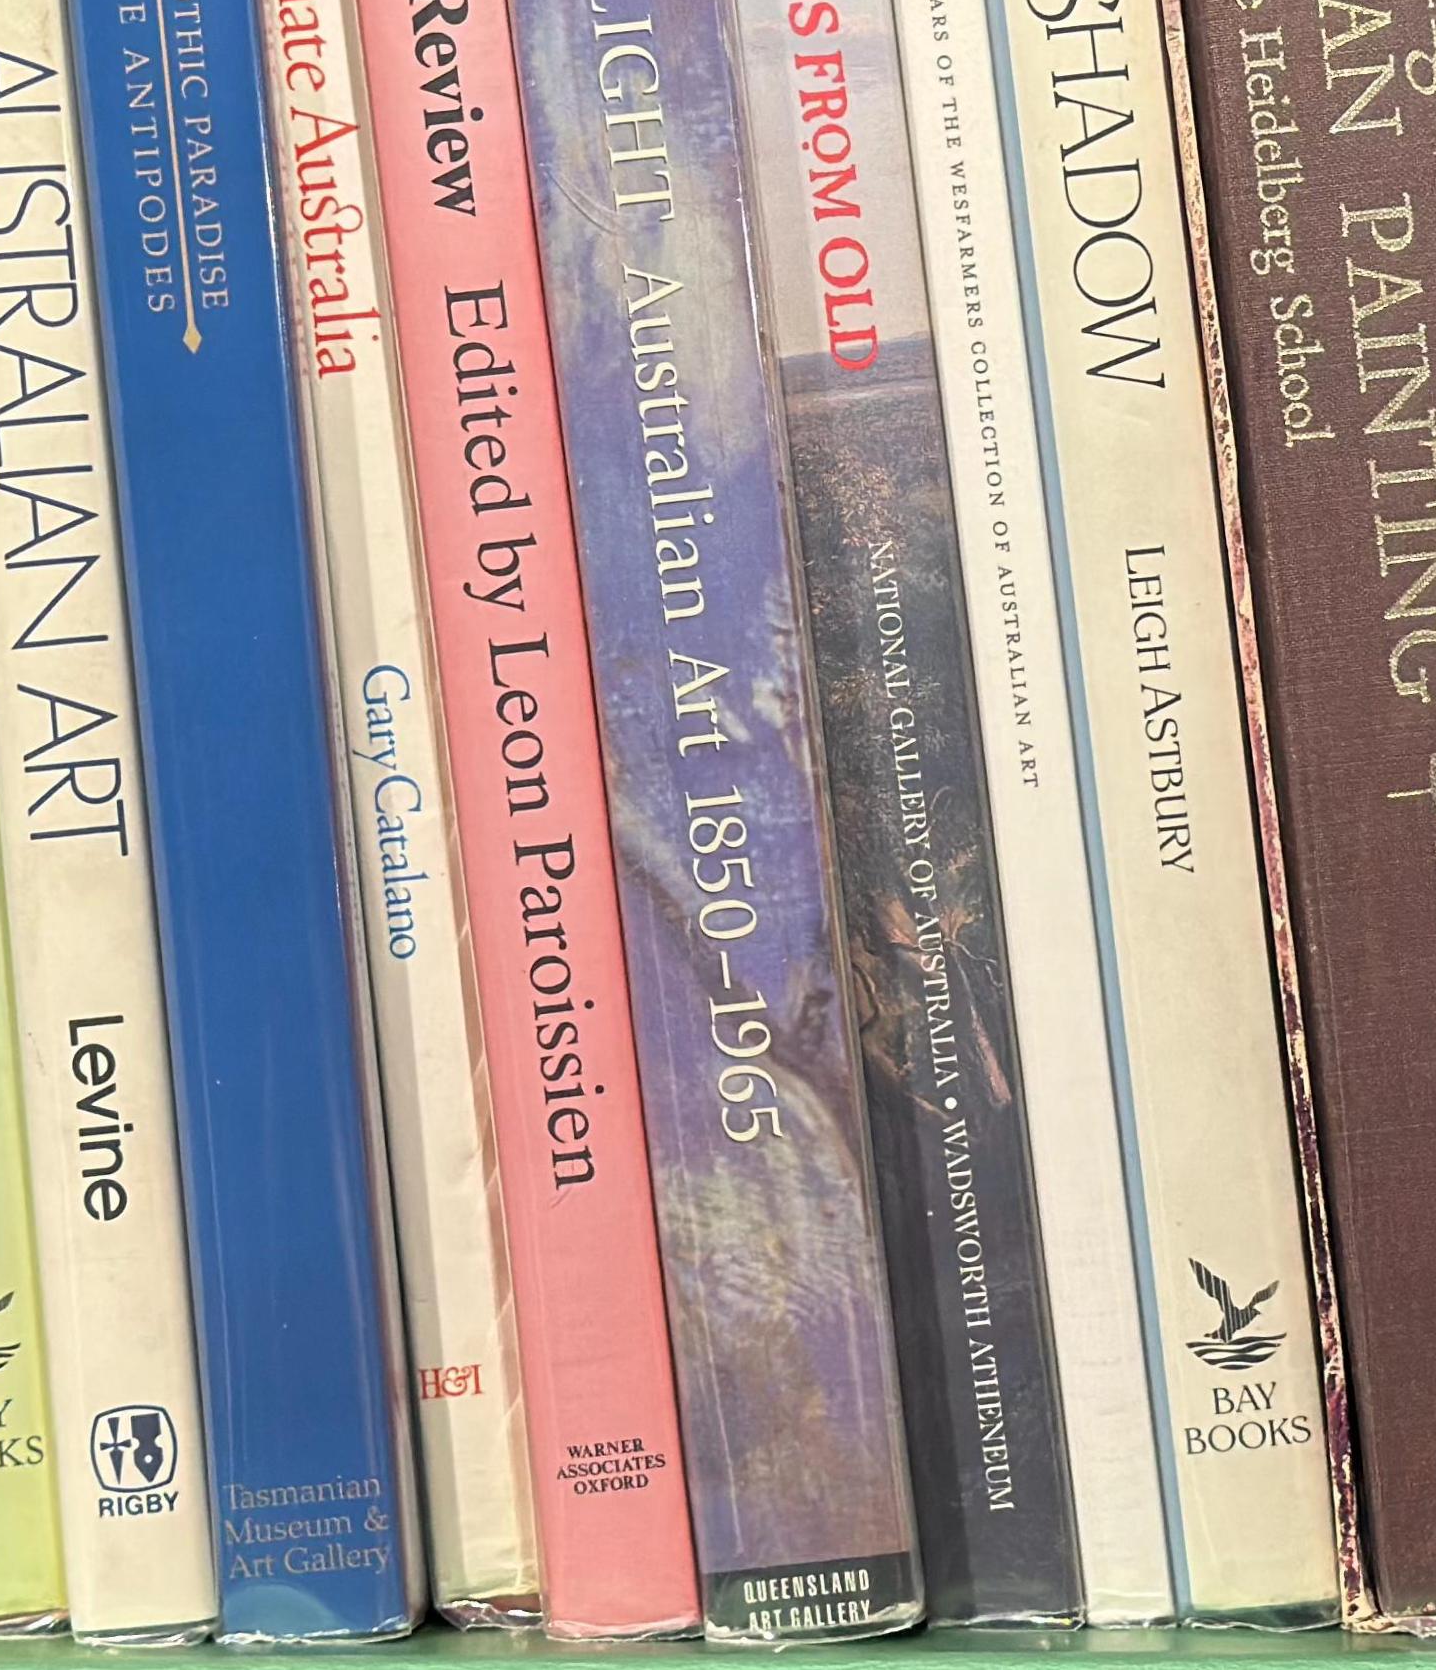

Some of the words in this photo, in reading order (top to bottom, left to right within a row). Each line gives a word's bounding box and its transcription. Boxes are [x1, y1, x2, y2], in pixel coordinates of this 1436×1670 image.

[797, 50, 861, 223] FROM
[937, 54, 953, 89] OF
[941, 96, 962, 149] THE
[123, 48, 175, 314] ANTIPODES
[184, 117, 229, 310] PARADISE
[1239, 25, 1303, 273] Heidelberg
[818, 236, 879, 373] OLD
[949, 160, 983, 330] WESFARMERS
[444, 283, 531, 518] Edited
[972, 341, 1005, 507] COLLECTION
[1269, 294, 1333, 445] School
[462, 534, 535, 614] by
[992, 521, 1010, 553] OF
[868, 540, 910, 698] NATIONAL
[998, 565, 1031, 725] AUSTRALIAN
[1124, 545, 1171, 678] LEIGH
[360, 664, 412, 772] Gary
[487, 637, 559, 817] Leon
[889, 707, 930, 848] GALLERY
[1018, 740, 1039, 788] ART
[1142, 680, 1195, 875] ASTBURY
[367, 775, 422, 961] Catalano
[909, 858, 937, 901] OF
[512, 834, 606, 1190] Paroissien
[916, 912, 959, 1087] AUSTRALIA
[67, 1016, 133, 1223] Levine
[942, 1120, 993, 1330] WADSWORTH
[971, 1340, 1016, 1513] ATHENEUM
[557, 1454, 666, 1479] ASSOCIATES
[567, 1438, 645, 1458] WARNER
[1184, 1416, 1312, 1455] BOOKS
[1212, 1382, 1278, 1416] BAY
[98, 1491, 178, 1517] RIGBY
[222, 1475, 381, 1511] Tasmanian
[224, 1513, 352, 1545] Museum
[363, 1507, 390, 1531] &
[574, 1474, 649, 1495] OXFORD
[229, 1554, 274, 1579] Art
[284, 1543, 390, 1573] Gallery
